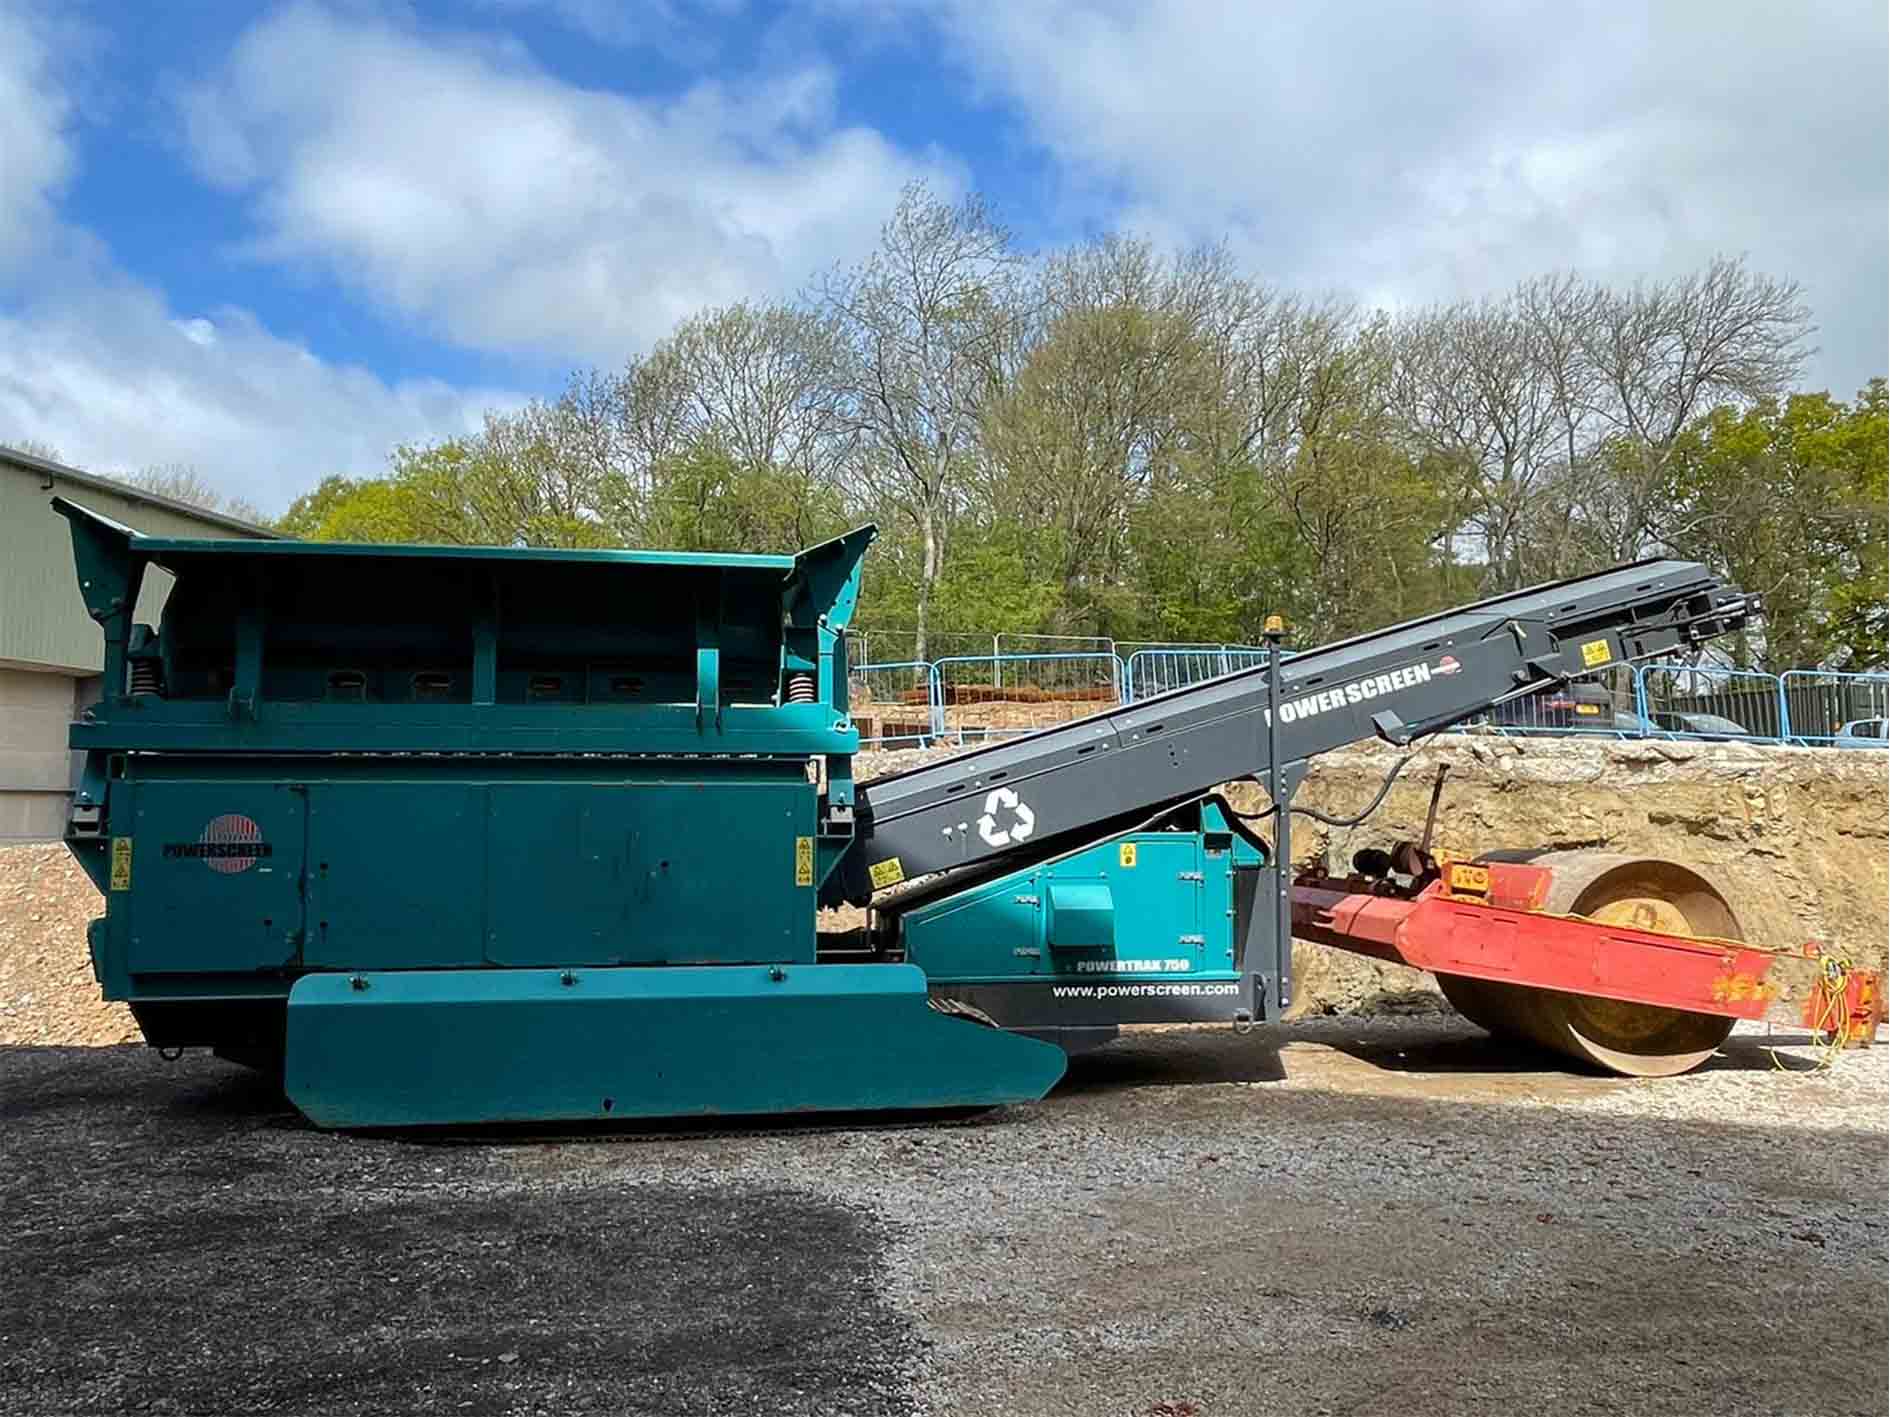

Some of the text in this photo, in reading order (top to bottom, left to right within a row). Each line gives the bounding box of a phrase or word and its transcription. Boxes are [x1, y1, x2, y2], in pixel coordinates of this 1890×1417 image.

[162, 842, 273, 859] POWERSCREEN
[1077, 958, 1190, 973] POWERTRAK 750
[1052, 983, 1240, 999] www.powerscreen.com
